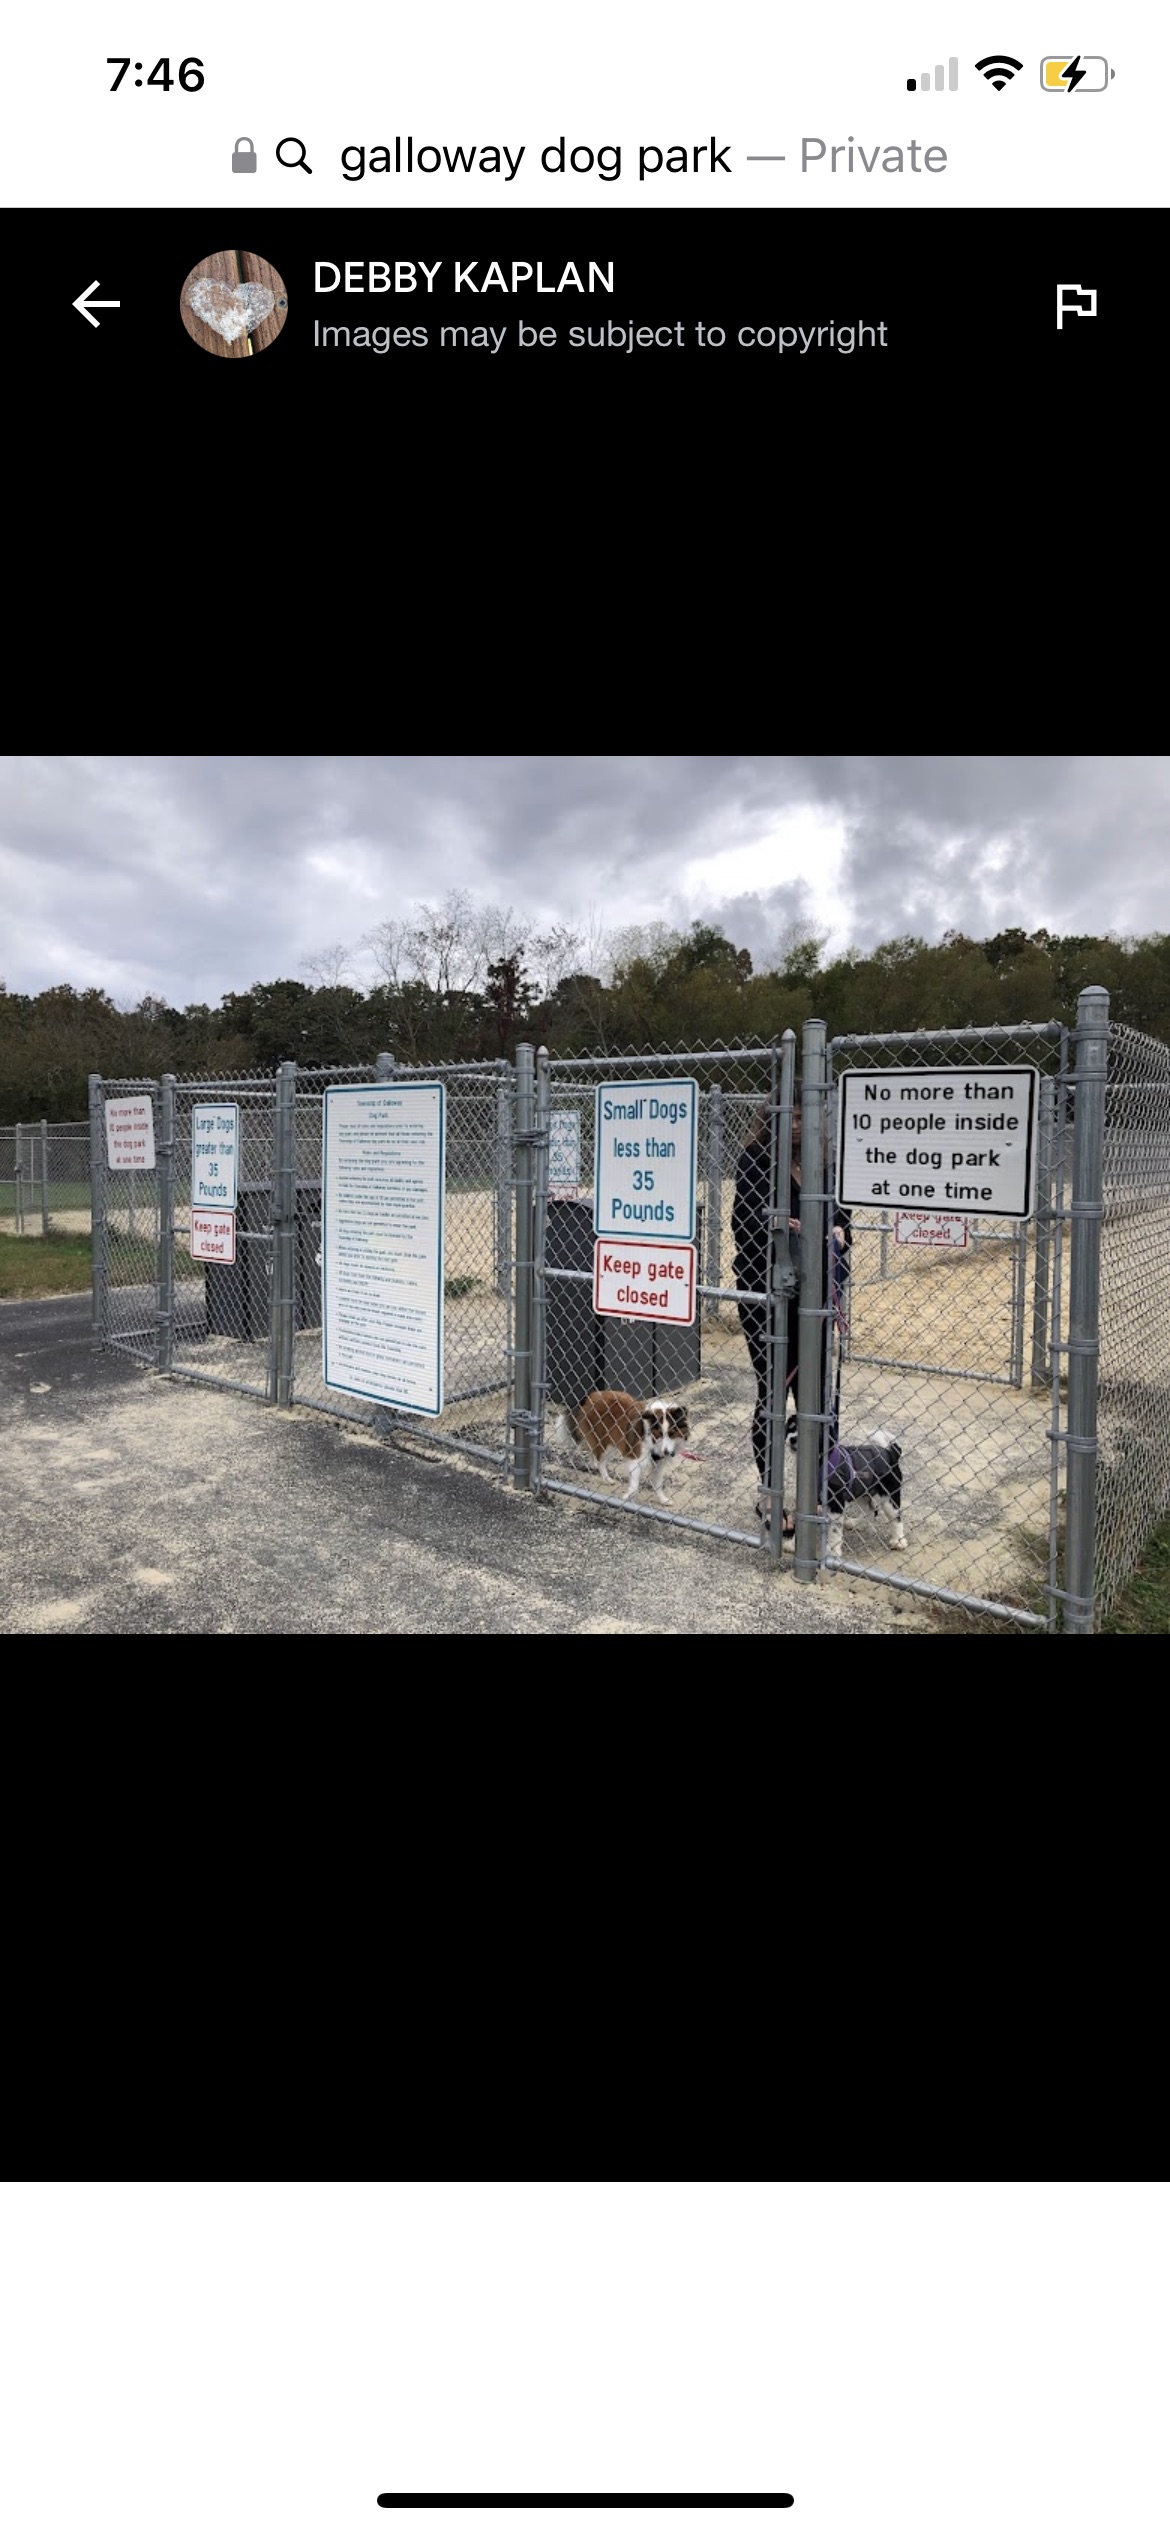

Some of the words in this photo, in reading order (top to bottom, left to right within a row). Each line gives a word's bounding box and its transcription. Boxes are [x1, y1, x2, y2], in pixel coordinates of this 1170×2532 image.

[864, 1084, 891, 1101] No
[900, 1086, 954, 1100] more
[964, 1083, 1014, 1100] than
[603, 1099, 643, 1120] Small
[649, 1099, 687, 1123] Dogs
[196, 1117, 214, 1133] Large
[216, 1116, 234, 1134] Dogs
[852, 1114, 871, 1130] 10
[880, 1113, 946, 1134] people
[955, 1113, 1019, 1130] inside
[195, 1143, 217, 1157] greater
[218, 1142, 234, 1155] than
[614, 1137, 640, 1157] less
[645, 1137, 675, 1158] than
[865, 1147, 896, 1164] the
[906, 1148, 942, 1169] dog
[952, 1149, 1000, 1169] park
[208, 1163, 218, 1177] 35
[199, 1182, 227, 1197] Pounds
[632, 1170, 654, 1191] 35
[871, 1180, 890, 1195] at
[899, 1183, 935, 1197] one
[945, 1182, 992, 1200] time
[612, 1199, 674, 1222] Pounds
[194, 1220, 212, 1234] Keep
[214, 1223, 230, 1236] gate
[913, 1228, 951, 1239] closed
[200, 1241, 224, 1254] closed
[603, 1255, 641, 1277] Keep
[647, 1261, 684, 1281] gate
[617, 1286, 668, 1307] closed
